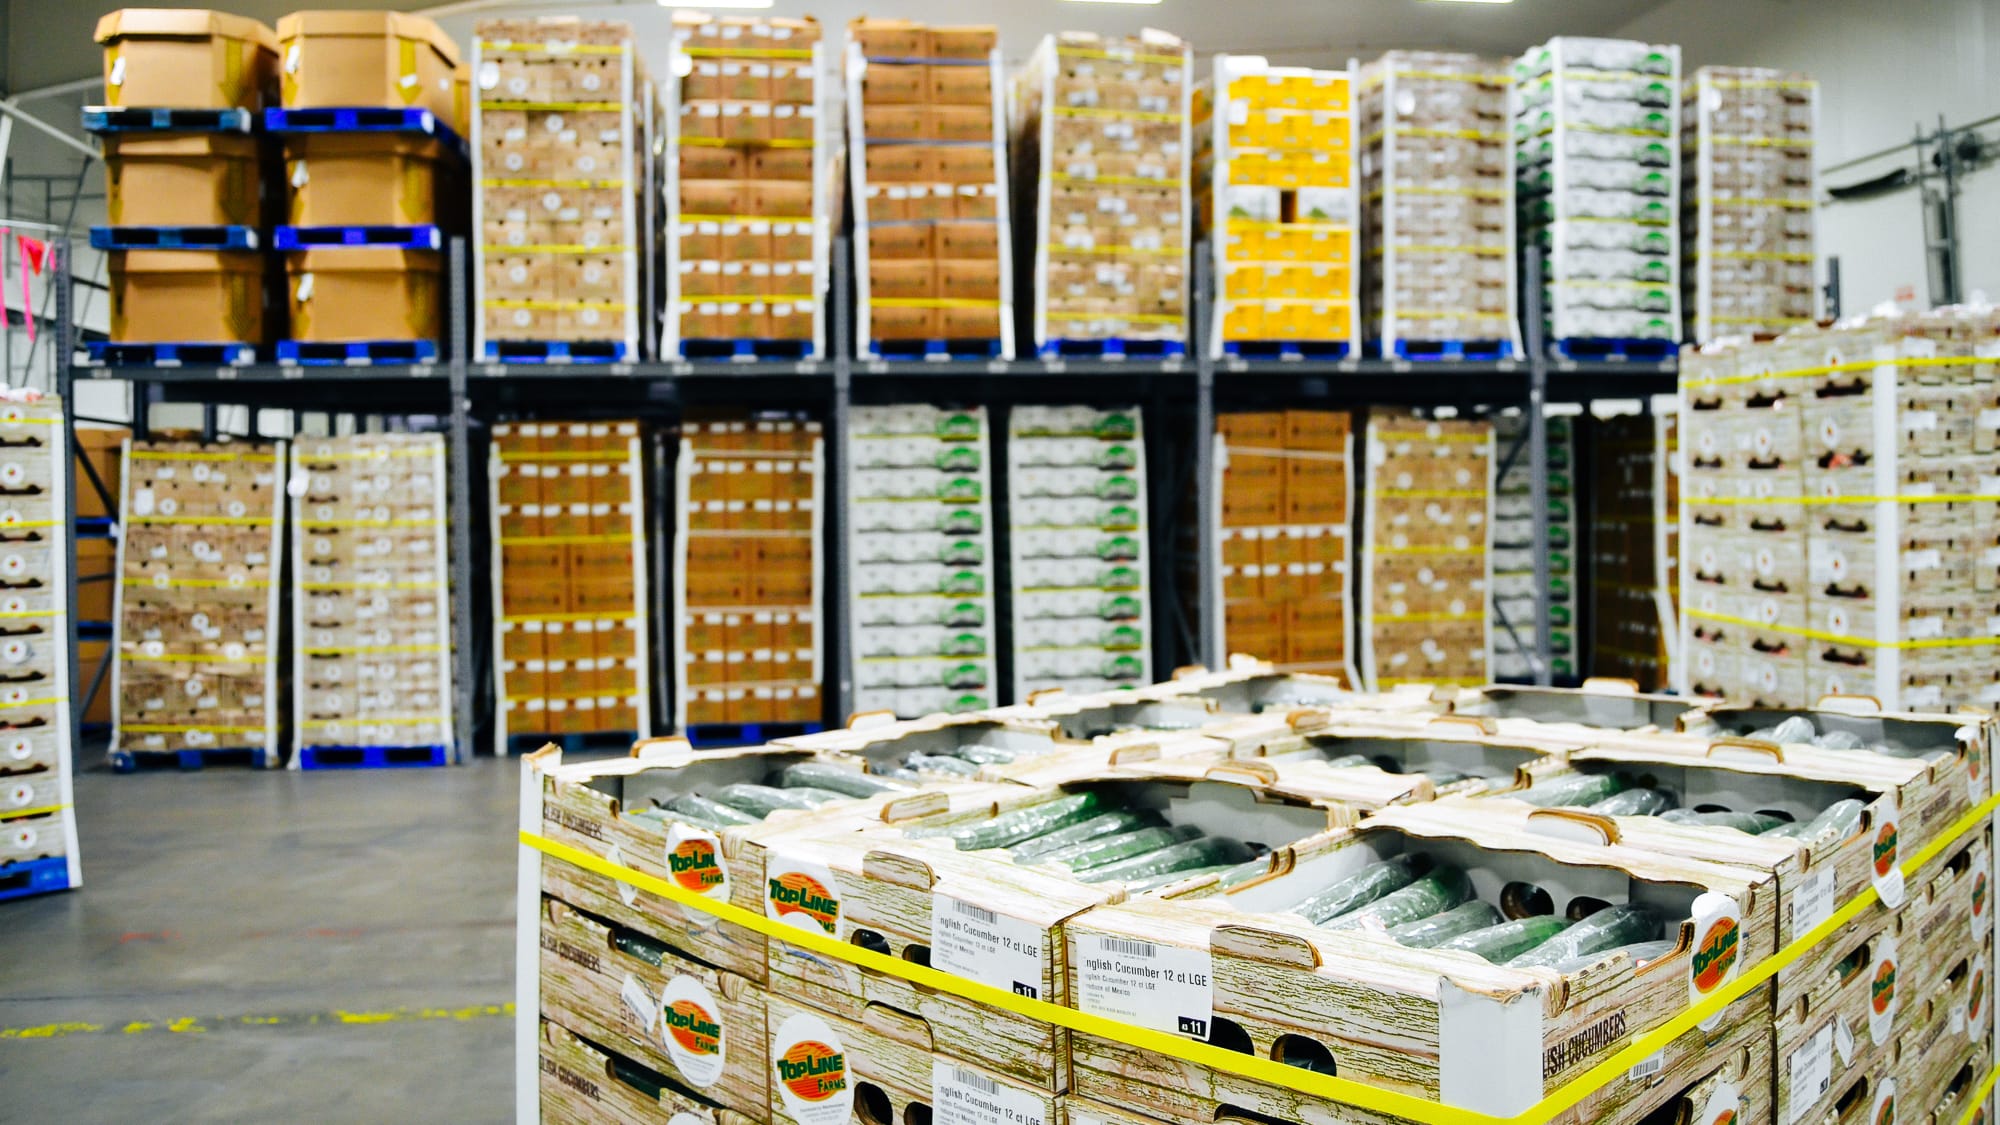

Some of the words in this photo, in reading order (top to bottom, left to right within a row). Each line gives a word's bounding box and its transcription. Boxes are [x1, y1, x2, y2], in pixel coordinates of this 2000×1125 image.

[668, 850, 718, 872] TOPLIN
[940, 916, 961, 931] nglish
[963, 923, 1000, 945] Cucumber
[1003, 936, 1011, 948] 12
[1013, 942, 1020, 952] ct
[1023, 943, 1038, 958] LGE
[1086, 958, 1112, 971] nglish
[1115, 961, 1160, 979] Cucumber
[1164, 970, 1174, 981] 12
[1177, 973, 1186, 984] ct
[1189, 973, 1207, 987] LGE
[1146, 982, 1155, 990] LGE
[1190, 1020, 1201, 1034] 11
[1542, 1041, 1565, 1080] LISH
[1568, 1009, 1626, 1066] CUCUMBERS
[818, 1079, 846, 1092] FARMS
[940, 1086, 963, 1100] nglish
[965, 1093, 1001, 1115] Cucumber
[1005, 1108, 1013, 1119] 12
[1016, 1114, 1023, 1123] ct
